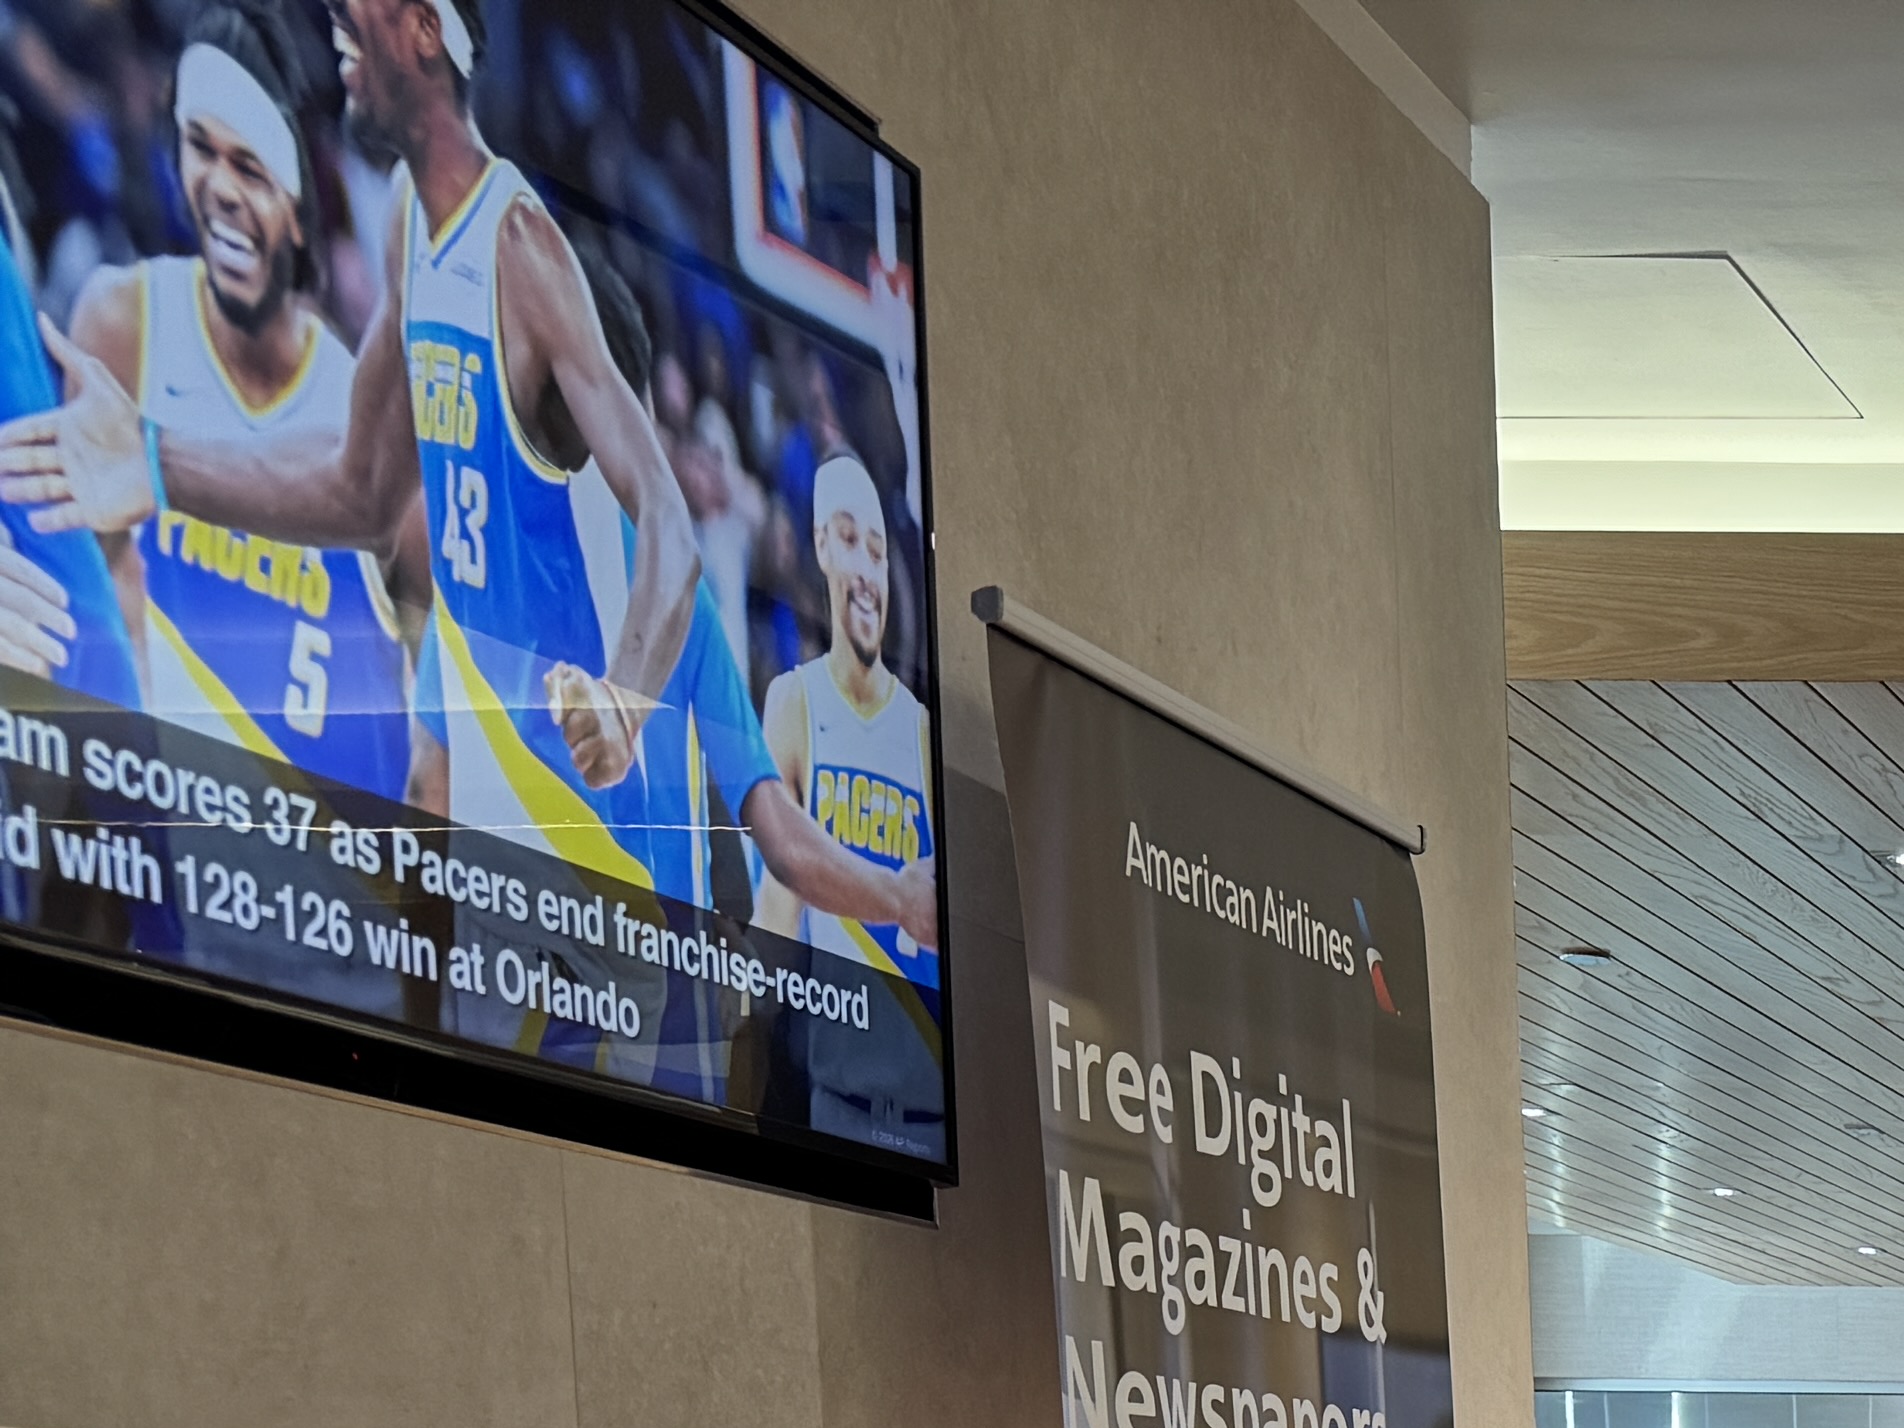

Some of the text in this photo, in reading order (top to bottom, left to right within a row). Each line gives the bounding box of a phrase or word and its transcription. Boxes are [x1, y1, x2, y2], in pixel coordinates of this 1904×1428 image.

[284, 620, 331, 738] 5
[83, 739, 252, 833] scores
[263, 786, 317, 852] 37
[329, 819, 381, 875] as
[393, 831, 528, 922] Pacers
[538, 889, 605, 947] end
[614, 902, 870, 1031] franchise-record
[816, 769, 920, 863] PACERS
[1126, 821, 1355, 976] American Airlines
[51, 826, 162, 904] with
[175, 854, 354, 958] 128-126
[363, 919, 438, 981] win
[449, 945, 487, 996] at
[496, 948, 641, 1038] Orlando
[1048, 999, 1355, 1207] Free Digital
[1058, 1169, 1387, 1345] Magazines &
